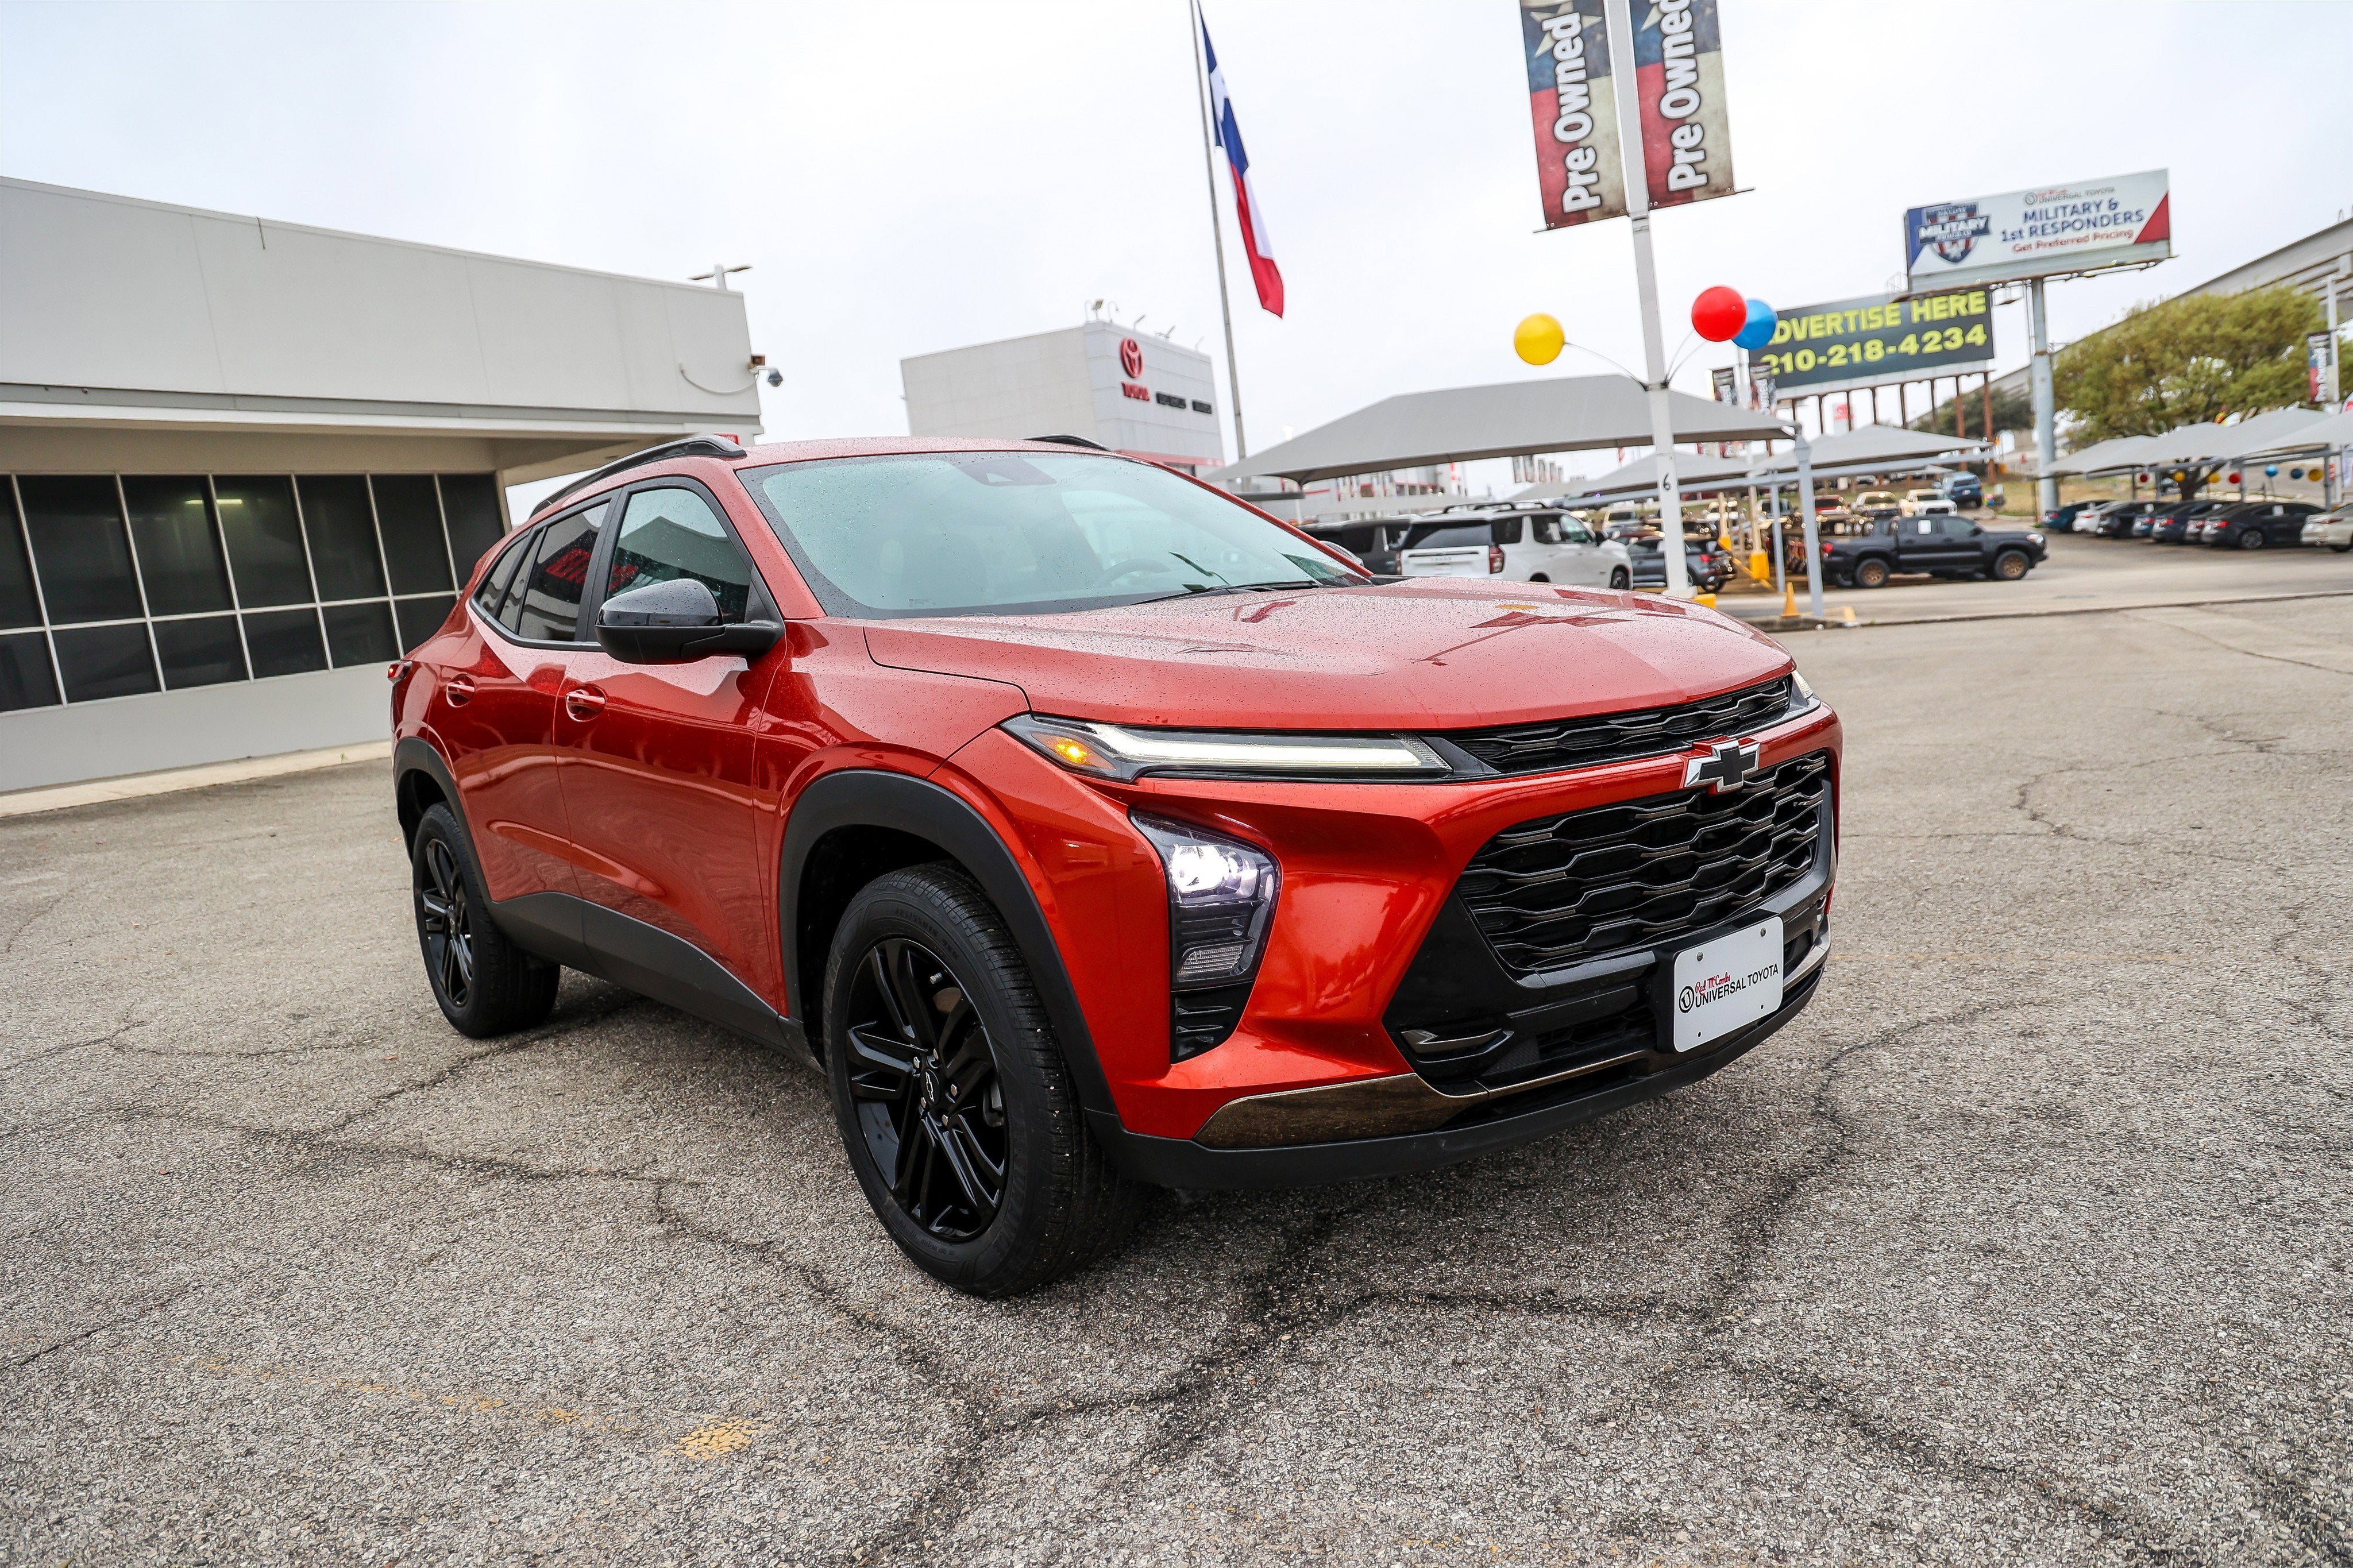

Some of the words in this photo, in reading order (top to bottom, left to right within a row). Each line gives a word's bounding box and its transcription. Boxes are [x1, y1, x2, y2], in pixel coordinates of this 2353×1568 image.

[1541, 11, 1594, 142] Owned
[1668, 123, 1708, 191] Pre
[1562, 146, 1602, 213] Pre
[2001, 229, 2024, 242] 1st
[2030, 208, 2144, 237] RESPONDERS
[2024, 199, 2103, 223] MILITARY
[2108, 196, 2119, 210] &
[1919, 217, 1988, 240] MILITARY
[2036, 235, 2089, 249] Preferred
[2093, 229, 2134, 241] Pricing
[1768, 303, 1901, 345] DVERTISE
[1911, 291, 1987, 323] HERE
[1663, 472, 1671, 491] 6
[1695, 978, 1746, 1007] UNIVERSAL
[1747, 963, 1779, 986] TOYOTA
[1695, 980, 1707, 996] Red
